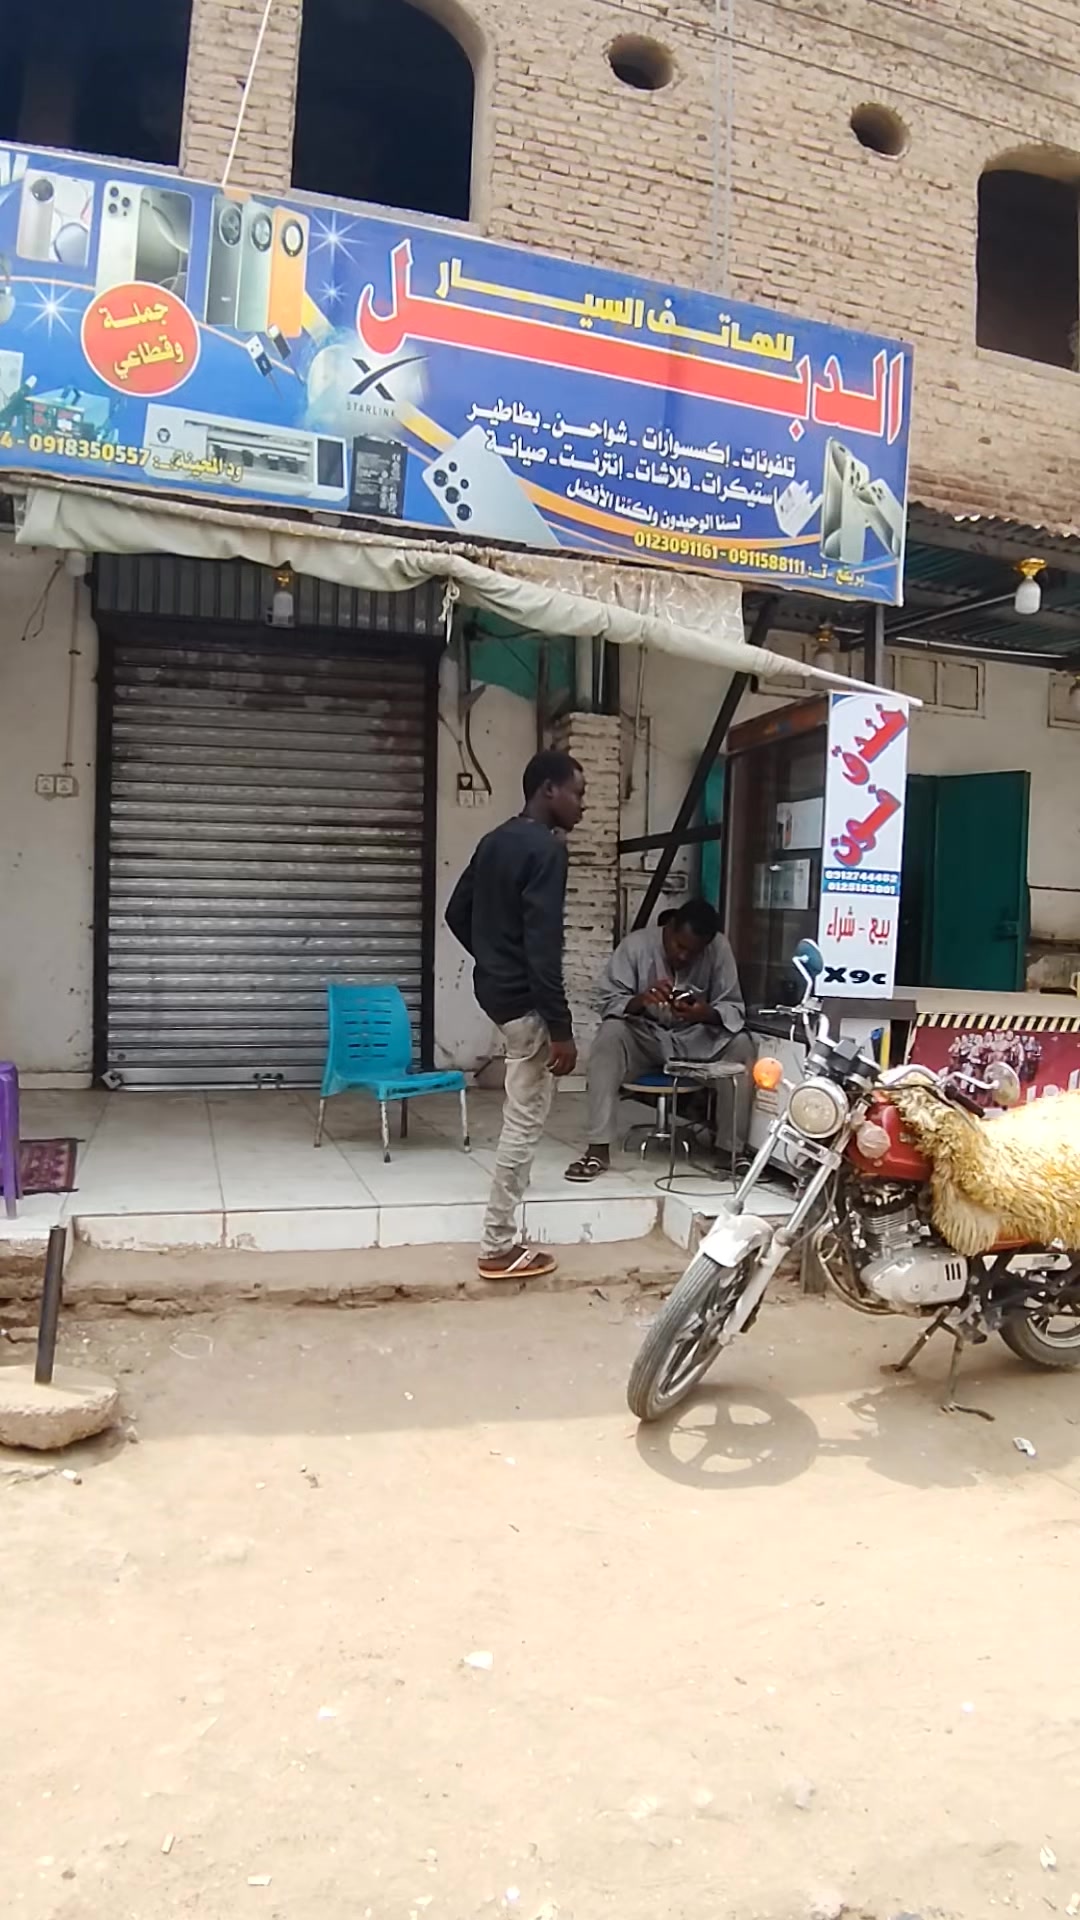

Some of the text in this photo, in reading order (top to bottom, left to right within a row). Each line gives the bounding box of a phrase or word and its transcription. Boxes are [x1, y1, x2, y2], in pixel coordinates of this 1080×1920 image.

[98, 302, 169, 328] جملة
[435, 258, 794, 362] للهاتف السيار
[113, 335, 184, 380] وقطاعي
[551, 411, 629, 447] شواحن
[29, 433, 151, 466] 0918350557
[485, 429, 548, 467] صيانة
[741, 447, 796, 479] تلفونات
[635, 458, 692, 489] فلاشات
[660, 510, 714, 534] الوحيدون
[715, 513, 742, 531] لسنا
[633, 531, 718, 560] 0123091161
[729, 548, 806, 575] 0911588111
[826, 905, 890, 945] بيع شراء
